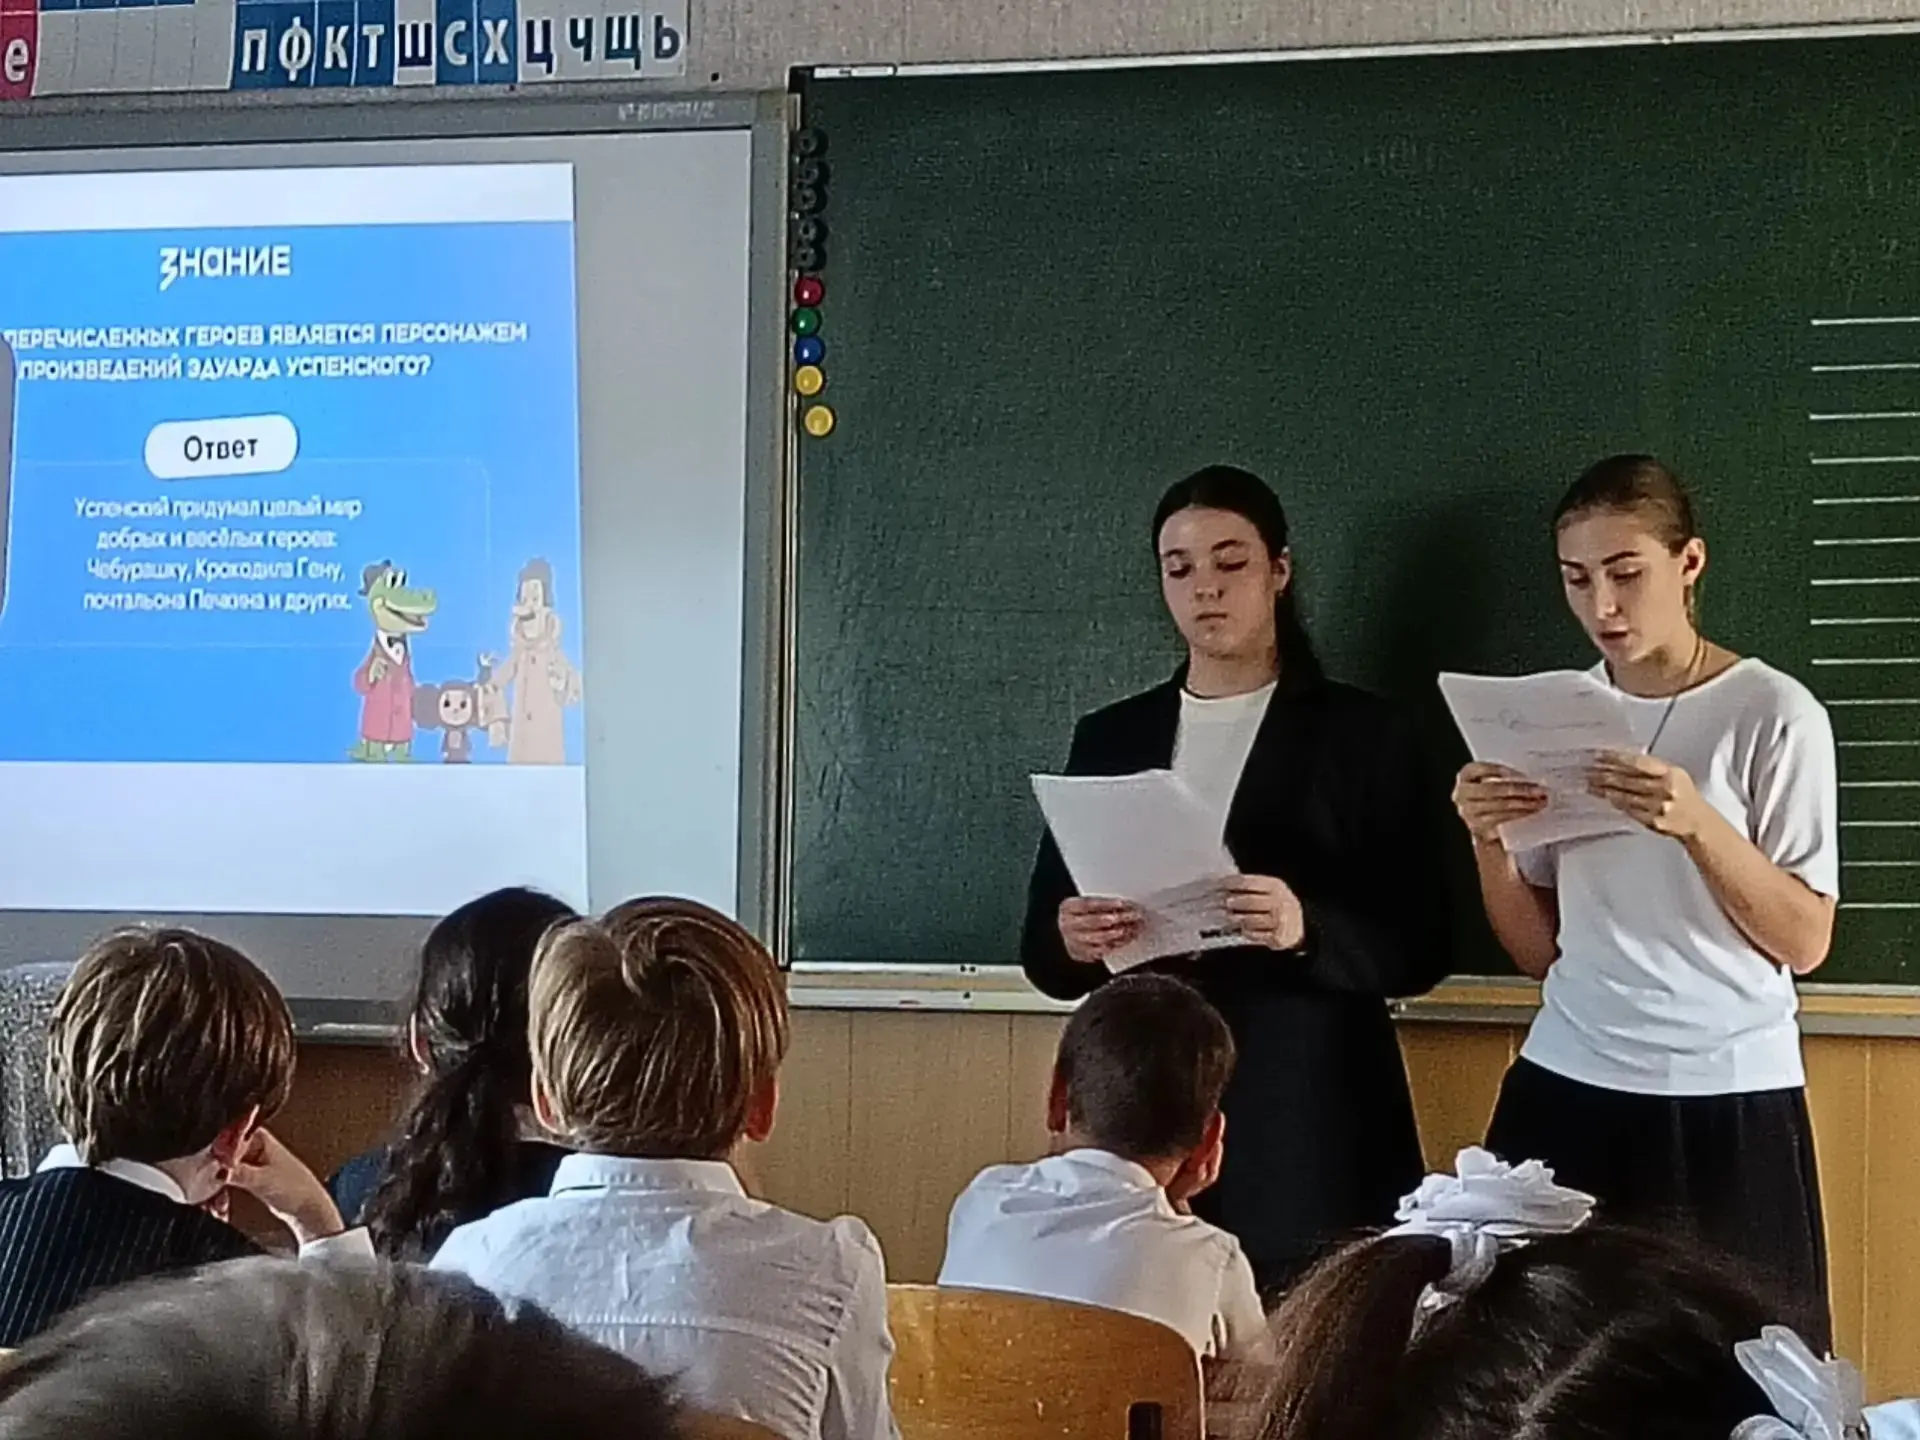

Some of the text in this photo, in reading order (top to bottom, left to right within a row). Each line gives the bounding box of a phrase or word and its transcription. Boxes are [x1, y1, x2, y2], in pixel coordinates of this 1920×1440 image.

[185, 323, 265, 348] ГЕРОЕВ
[269, 323, 376, 346] ЯВЛЯЕТСЯ
[381, 321, 528, 344] ПЕРСОНАЖЕМ
[18, 352, 432, 381] ПРОИЗВЕДЕНИЙ ЭДУАРДА УСПЕНСКОГО?
[184, 435, 258, 462] Ответ
[74, 496, 169, 518] Успенский
[172, 499, 261, 521] придумал
[96, 525, 166, 552] добрых
[170, 531, 183, 548] и
[87, 556, 192, 583] Чебурашку,
[195, 557, 294, 583] Крокодила
[84, 587, 353, 615] почтальона Печкина и других.
